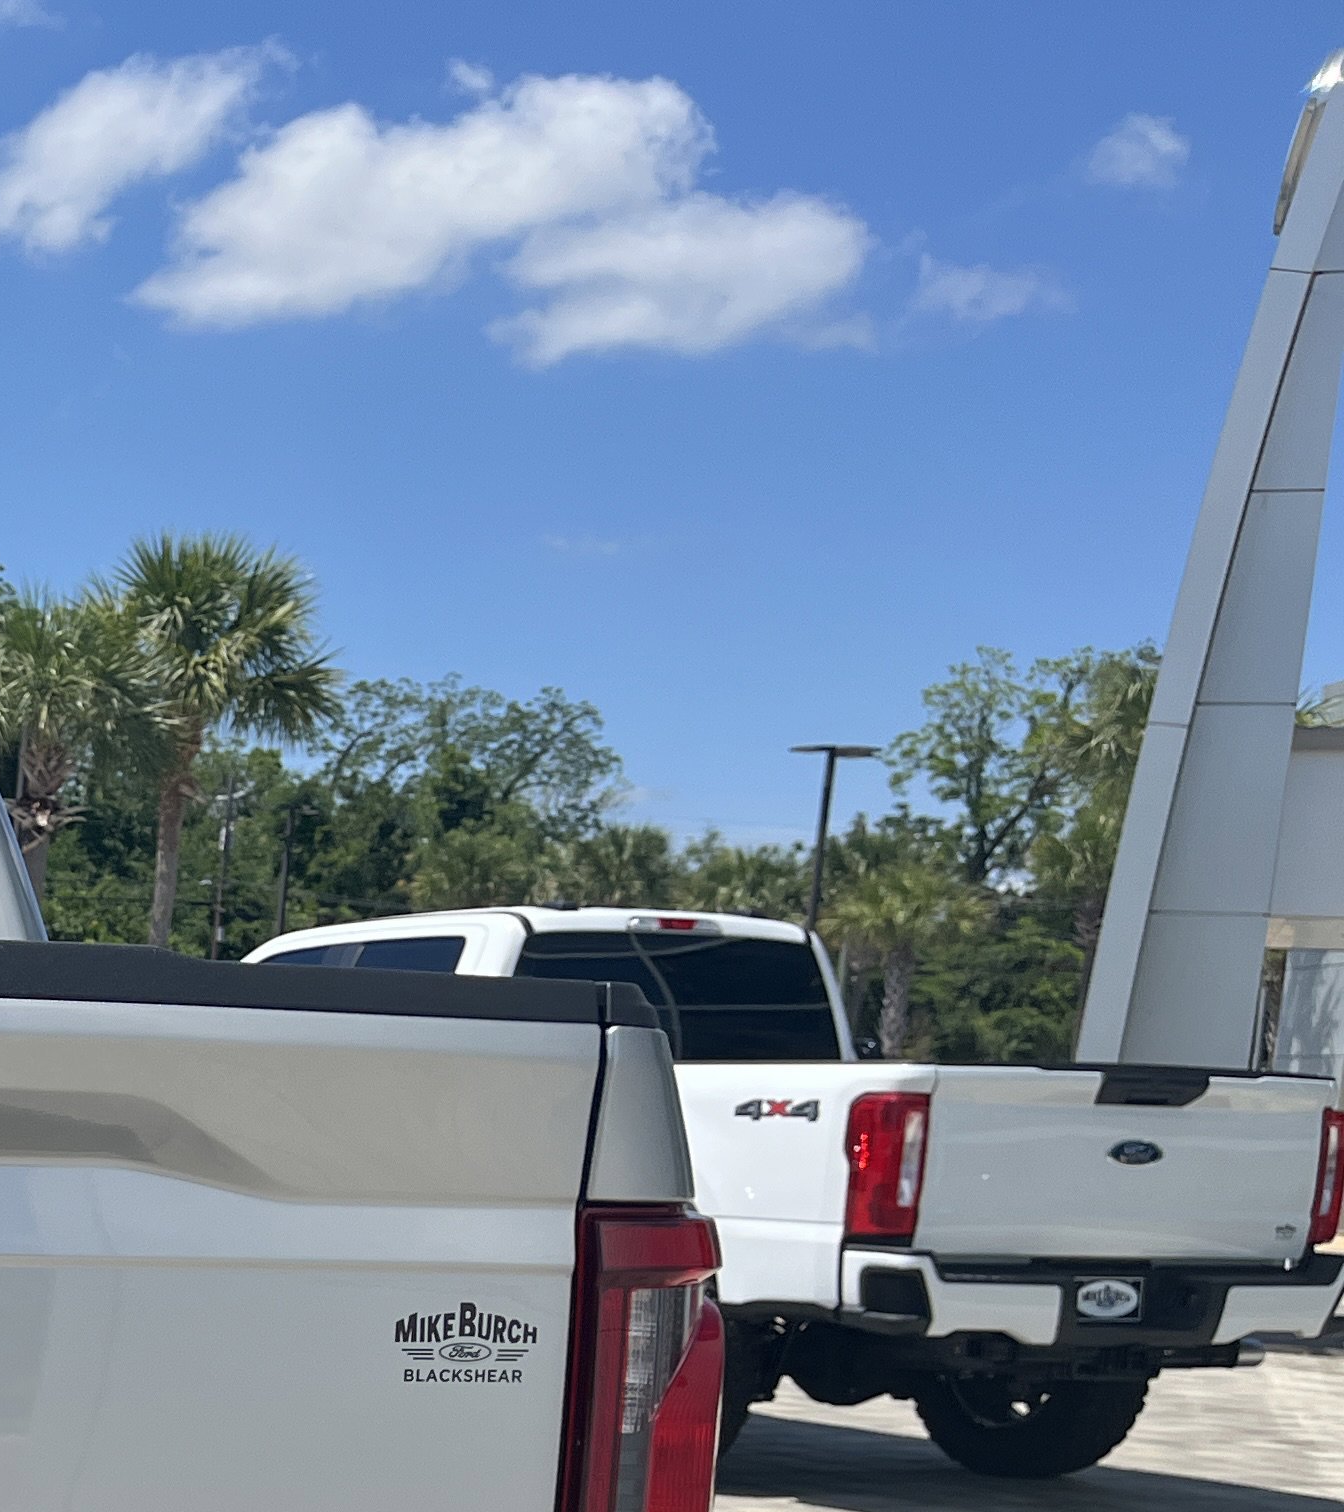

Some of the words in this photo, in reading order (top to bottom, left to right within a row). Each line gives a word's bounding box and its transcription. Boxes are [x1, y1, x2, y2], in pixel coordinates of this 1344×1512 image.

[395, 1312, 456, 1343] MIKE
[458, 1302, 538, 1344] BURCH
[448, 1345, 482, 1359] Ford
[403, 1368, 523, 1383] BLACKSHEAR
